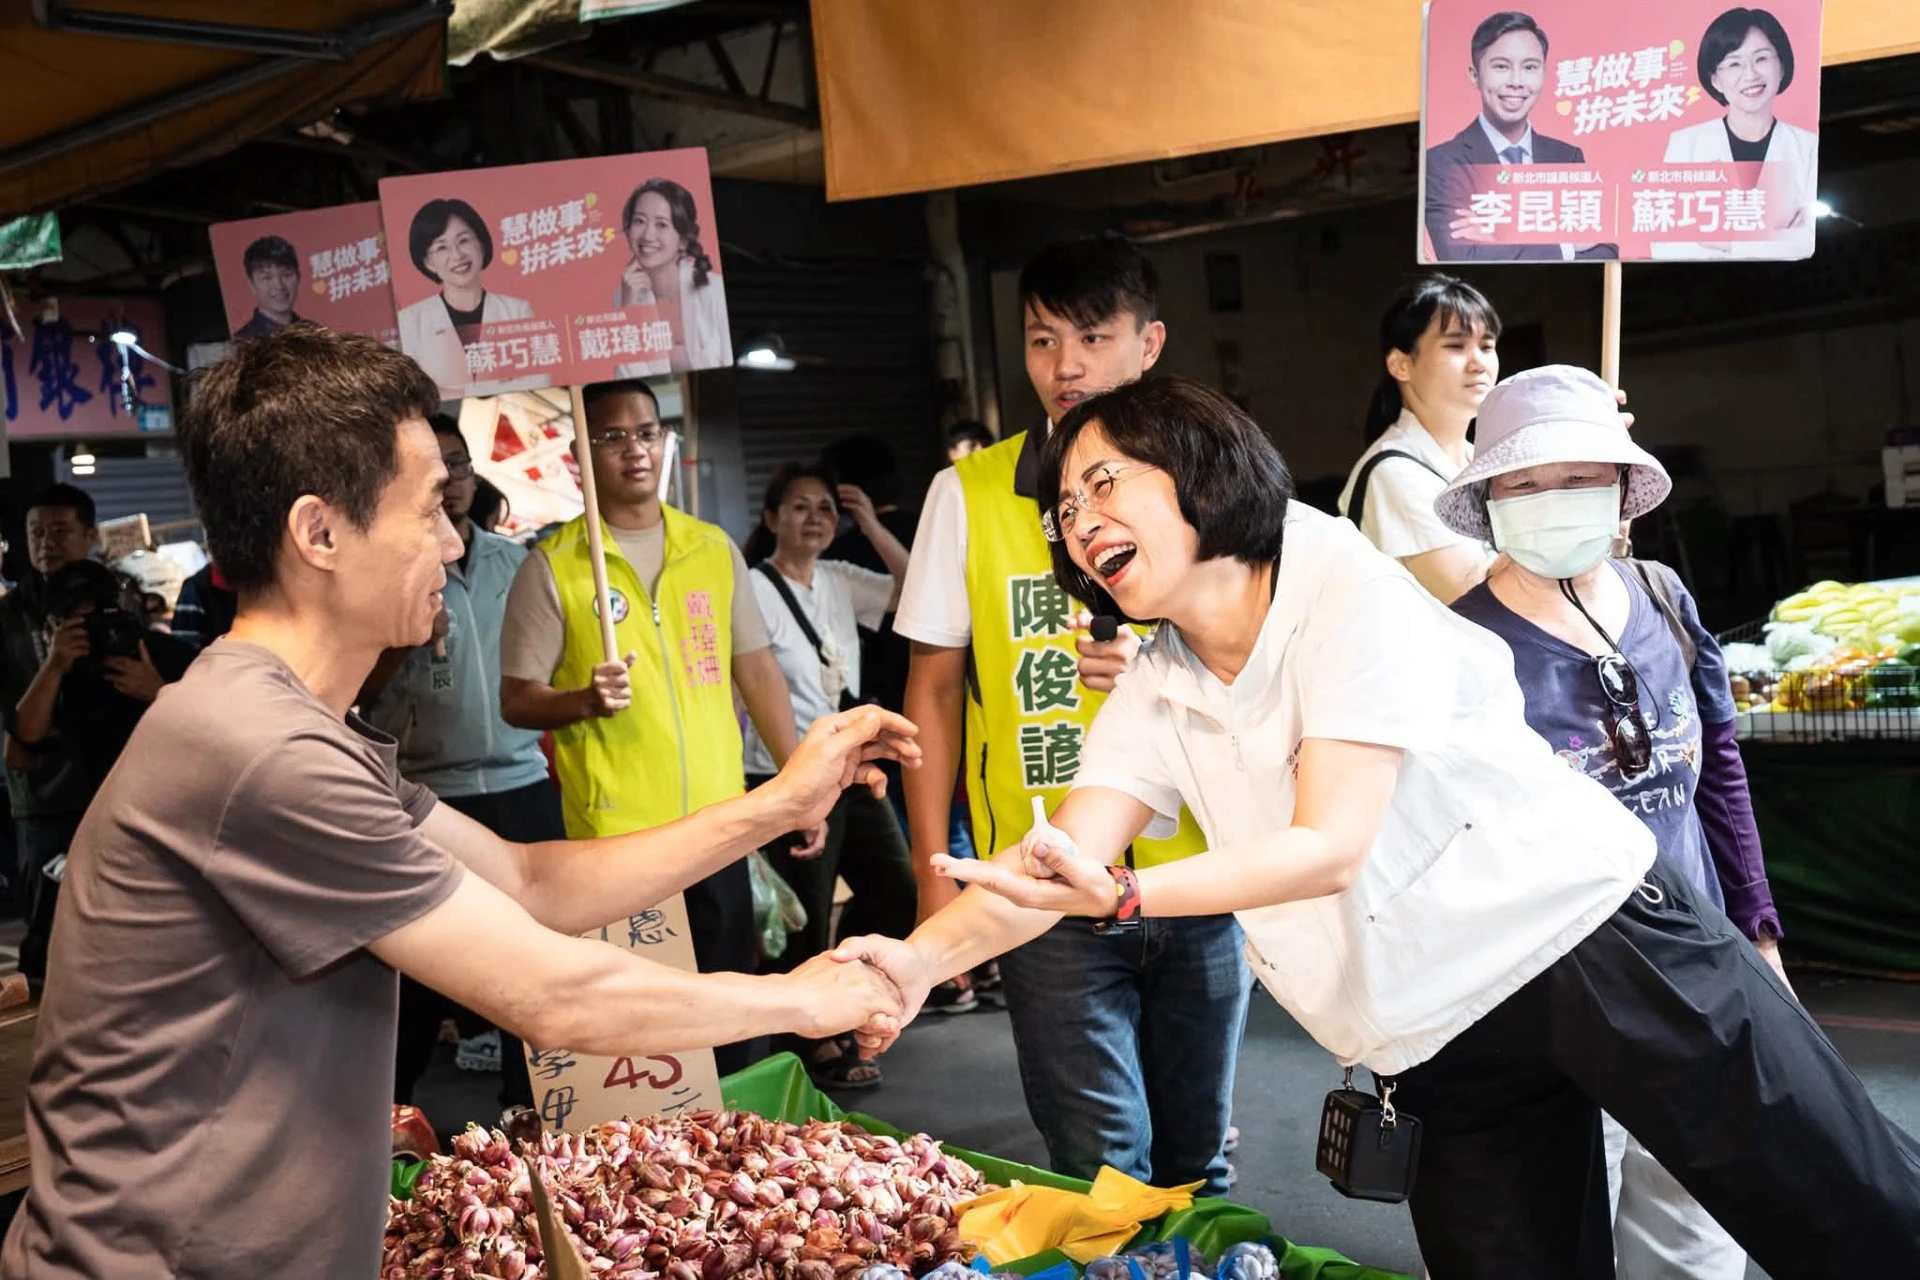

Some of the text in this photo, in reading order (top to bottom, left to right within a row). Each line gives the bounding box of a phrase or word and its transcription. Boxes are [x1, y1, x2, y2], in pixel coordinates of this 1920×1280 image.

[1554, 46, 1668, 97] 慧做事
[1573, 84, 1685, 136] 拚未來
[501, 199, 587, 247] 慧做事
[1469, 190, 1603, 234] 李昆穎
[1631, 188, 1767, 233] 蘇巧慧
[309, 236, 380, 278] 慧做事
[464, 333, 563, 375] 蘇巧慧
[578, 320, 674, 361] 戴瑋姍
[1011, 572, 1081, 787] 陳俊諺
